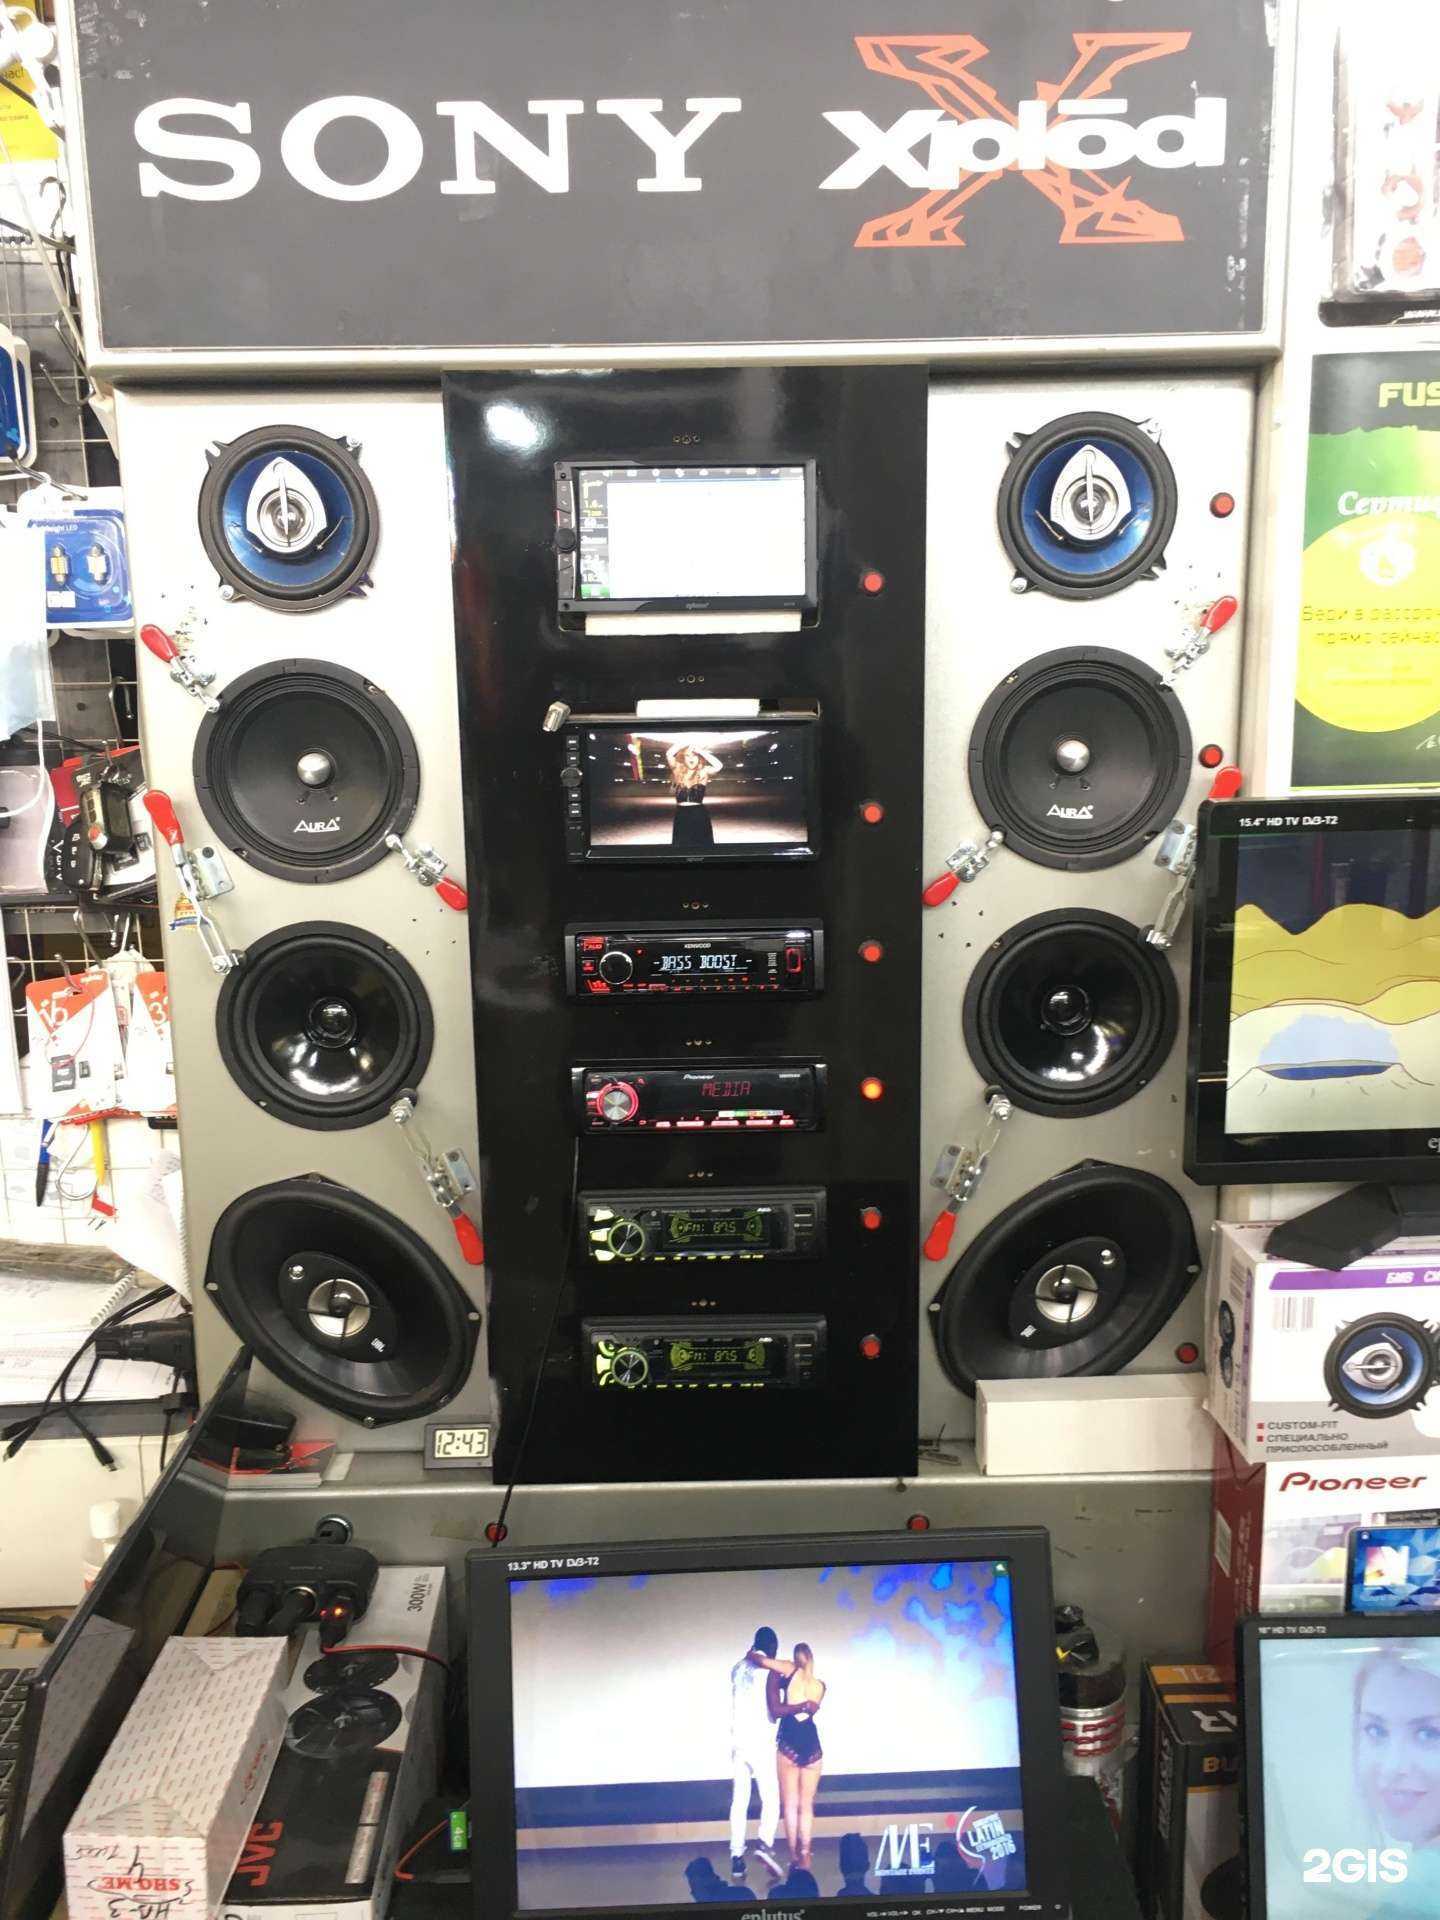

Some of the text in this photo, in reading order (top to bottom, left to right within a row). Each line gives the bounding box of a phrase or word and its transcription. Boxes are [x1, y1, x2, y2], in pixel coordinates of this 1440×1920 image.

[134, 95, 742, 201] SONY
[1266, 817, 1283, 826] HD
[1284, 816, 1300, 825] TV
[701, 1080, 751, 1097] MEDIA
[1267, 1420, 1339, 1430] CUSTOM-FIT
[437, 1432, 487, 1455] 12:43
[1266, 1432, 1348, 1443] СПЕЦИАЛЬНО
[1266, 1440, 1389, 1453] ПРИСПОСОБЛЕННЫЙ
[1279, 1472, 1427, 1492] Pioneer
[533, 1560, 549, 1569] HD
[550, 1559, 564, 1568] TV
[407, 1583, 427, 1612] 300W
[233, 1821, 284, 1887] JVC
